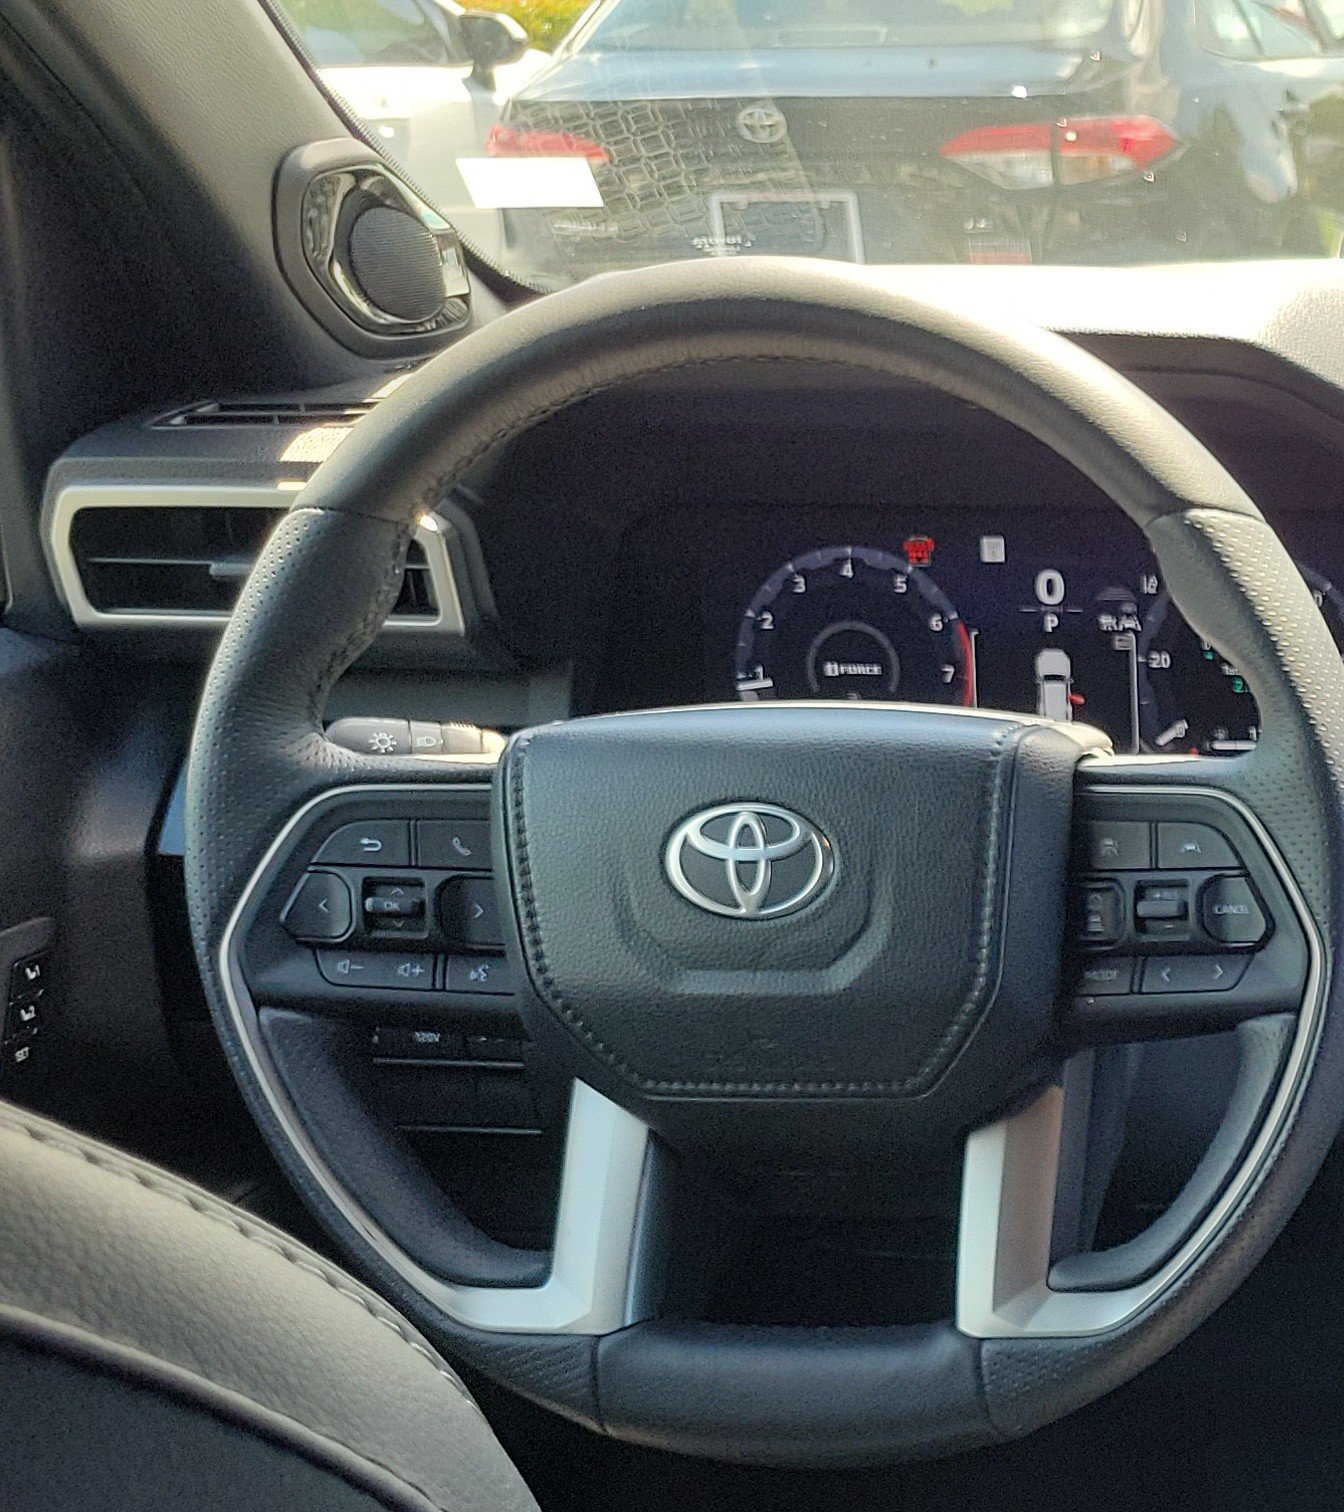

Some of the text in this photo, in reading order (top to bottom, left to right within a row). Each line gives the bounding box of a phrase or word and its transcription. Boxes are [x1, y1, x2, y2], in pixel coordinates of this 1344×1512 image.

[839, 559, 854, 579] 4
[792, 574, 807, 593] 3
[893, 576, 908, 594] 5
[1034, 567, 1066, 606] 0
[760, 611, 774, 630] 2
[929, 614, 944, 632] 6
[1043, 613, 1060, 633] P
[1148, 651, 1172, 669] 20
[940, 664, 956, 683] 7
